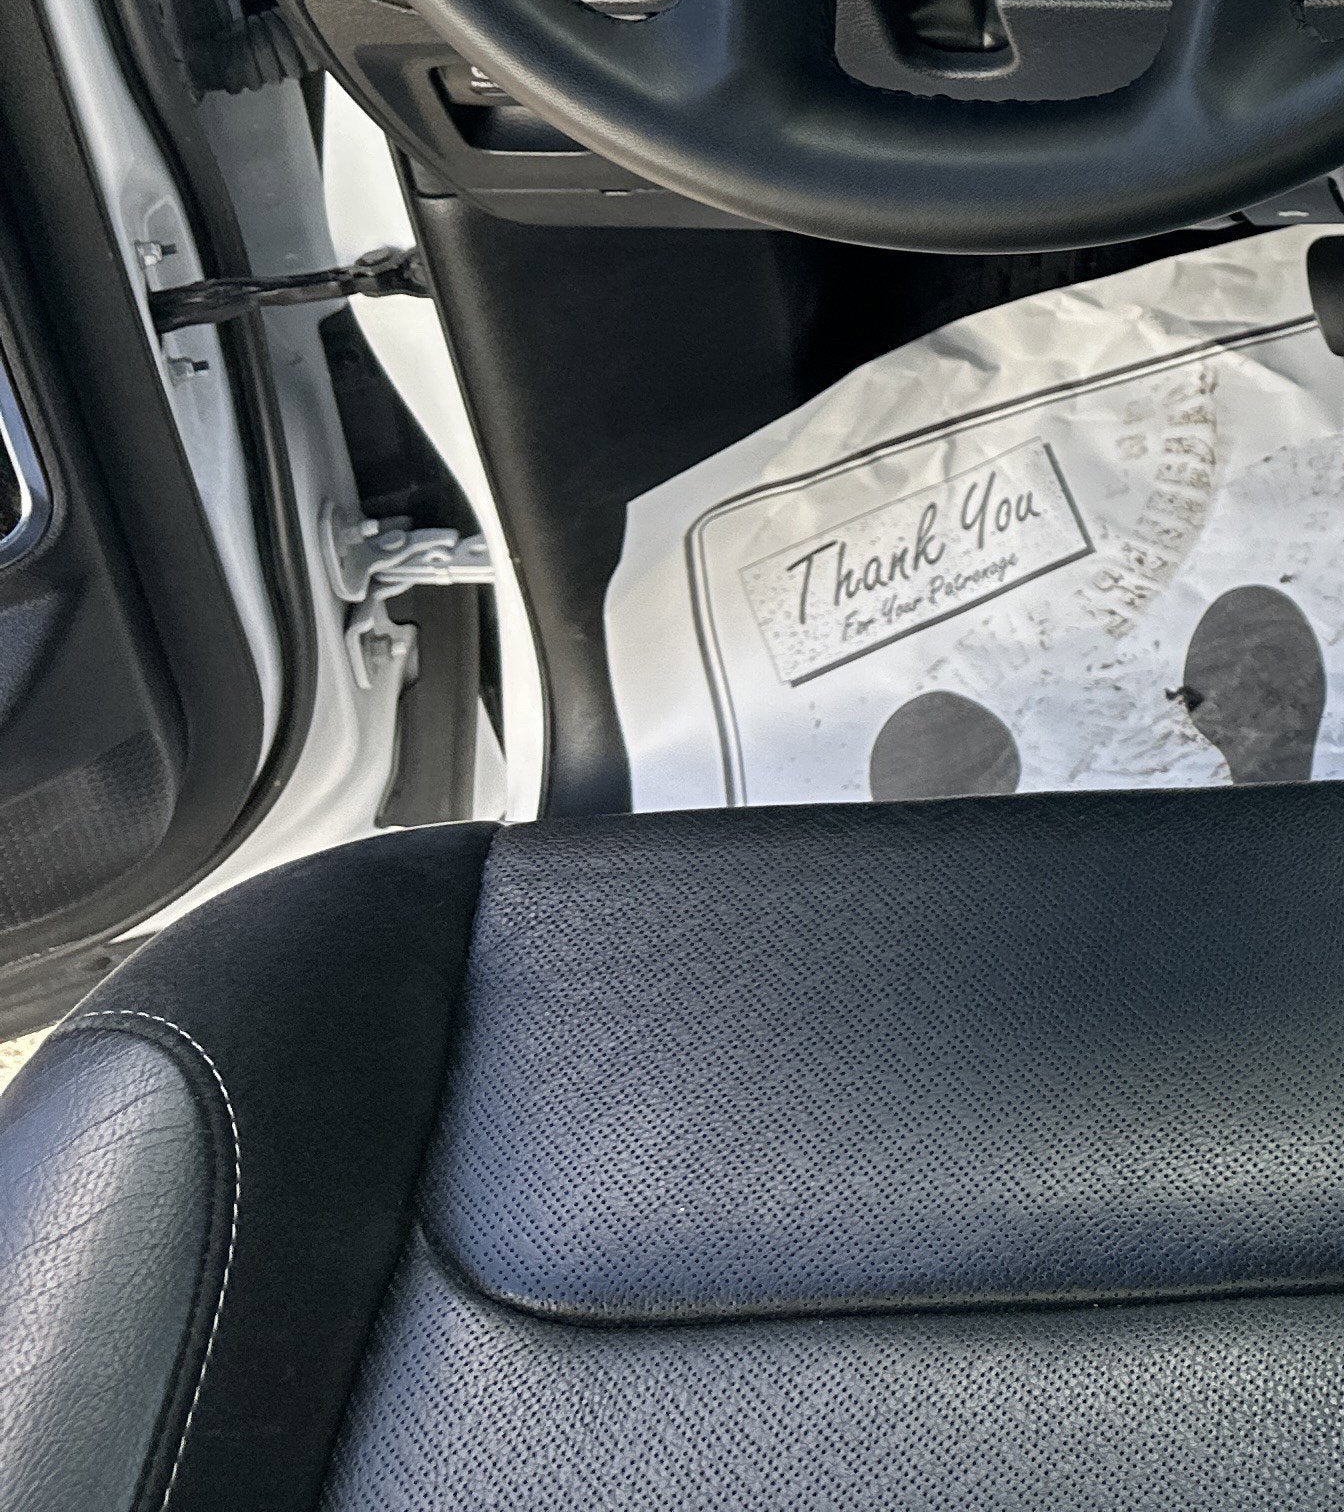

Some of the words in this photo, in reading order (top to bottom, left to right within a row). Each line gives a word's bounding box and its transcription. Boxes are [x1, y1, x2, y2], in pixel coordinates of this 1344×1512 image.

[786, 501, 947, 626] Thank
[960, 470, 1042, 551] You
[842, 612, 876, 642] For
[881, 595, 925, 626] Your
[927, 551, 1019, 605] Patronage
